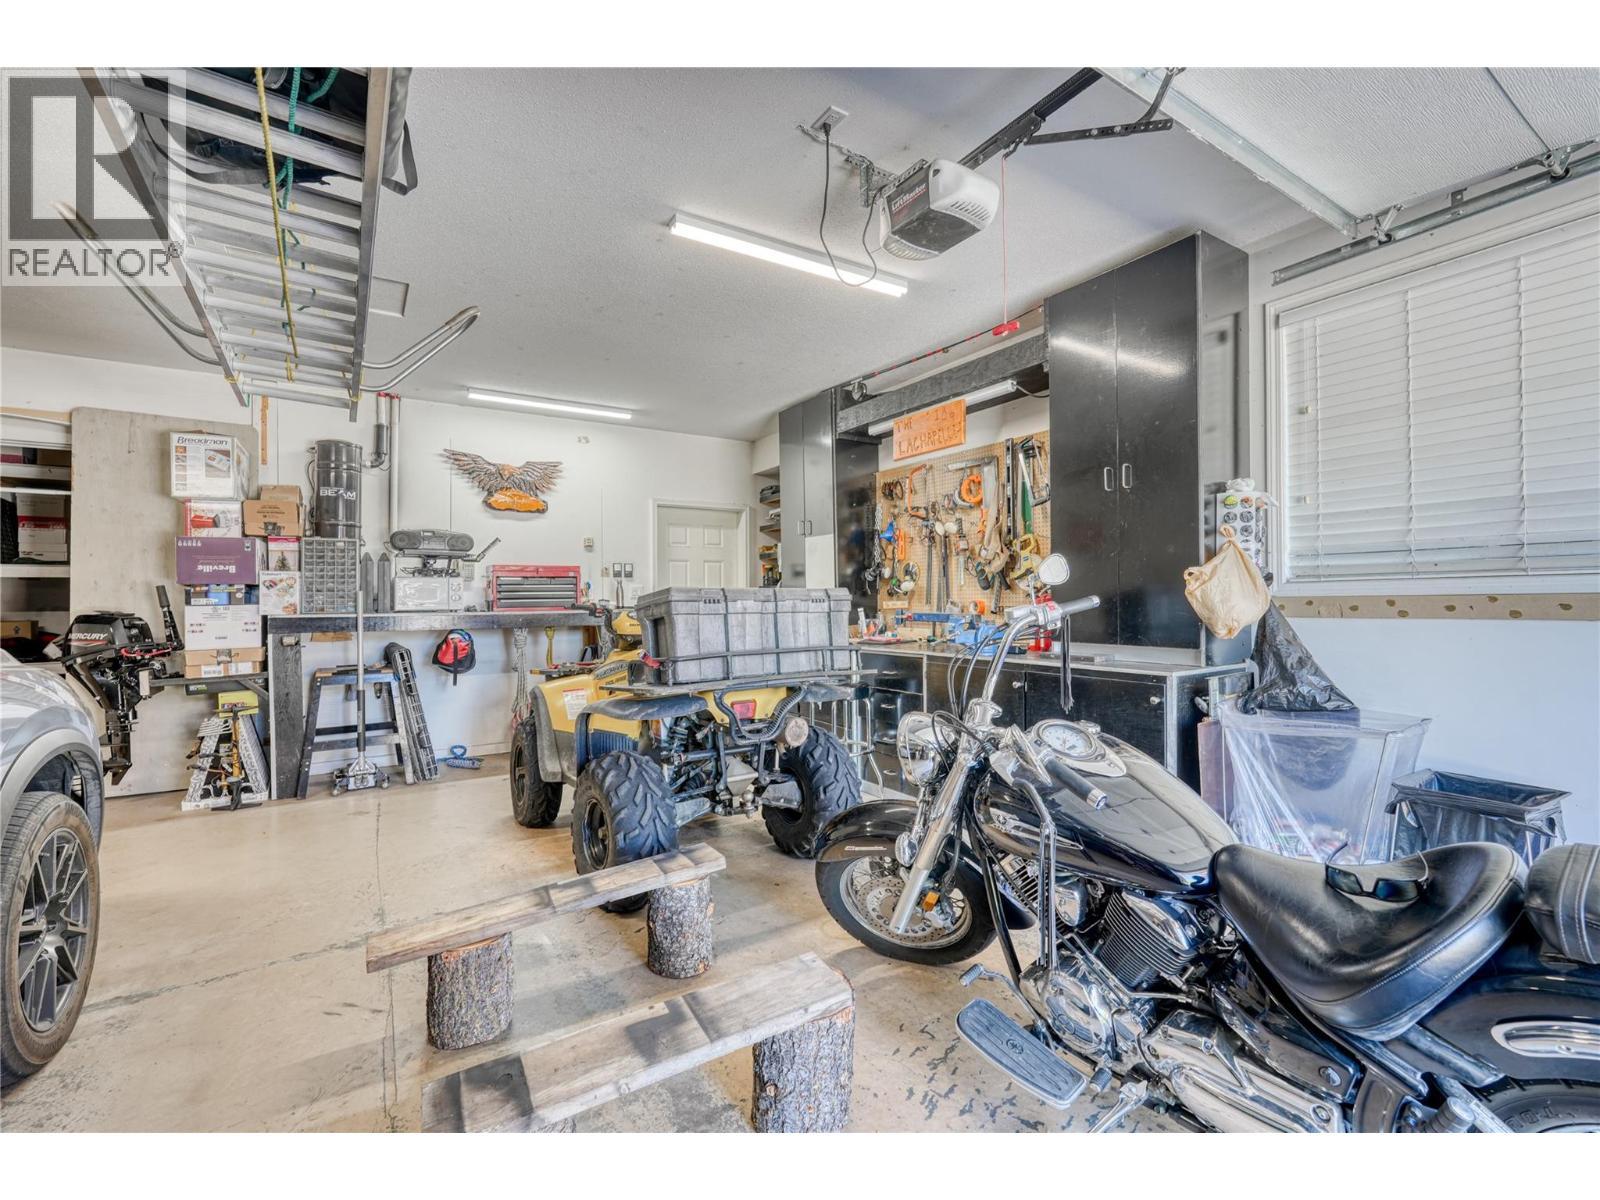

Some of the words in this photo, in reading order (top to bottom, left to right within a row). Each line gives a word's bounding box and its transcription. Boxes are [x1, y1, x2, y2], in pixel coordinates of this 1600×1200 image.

[177, 435, 229, 446] Breadman
[319, 487, 357, 501] BEAM
[196, 564, 237, 574] Breville
[68, 632, 109, 640] MERCURY
